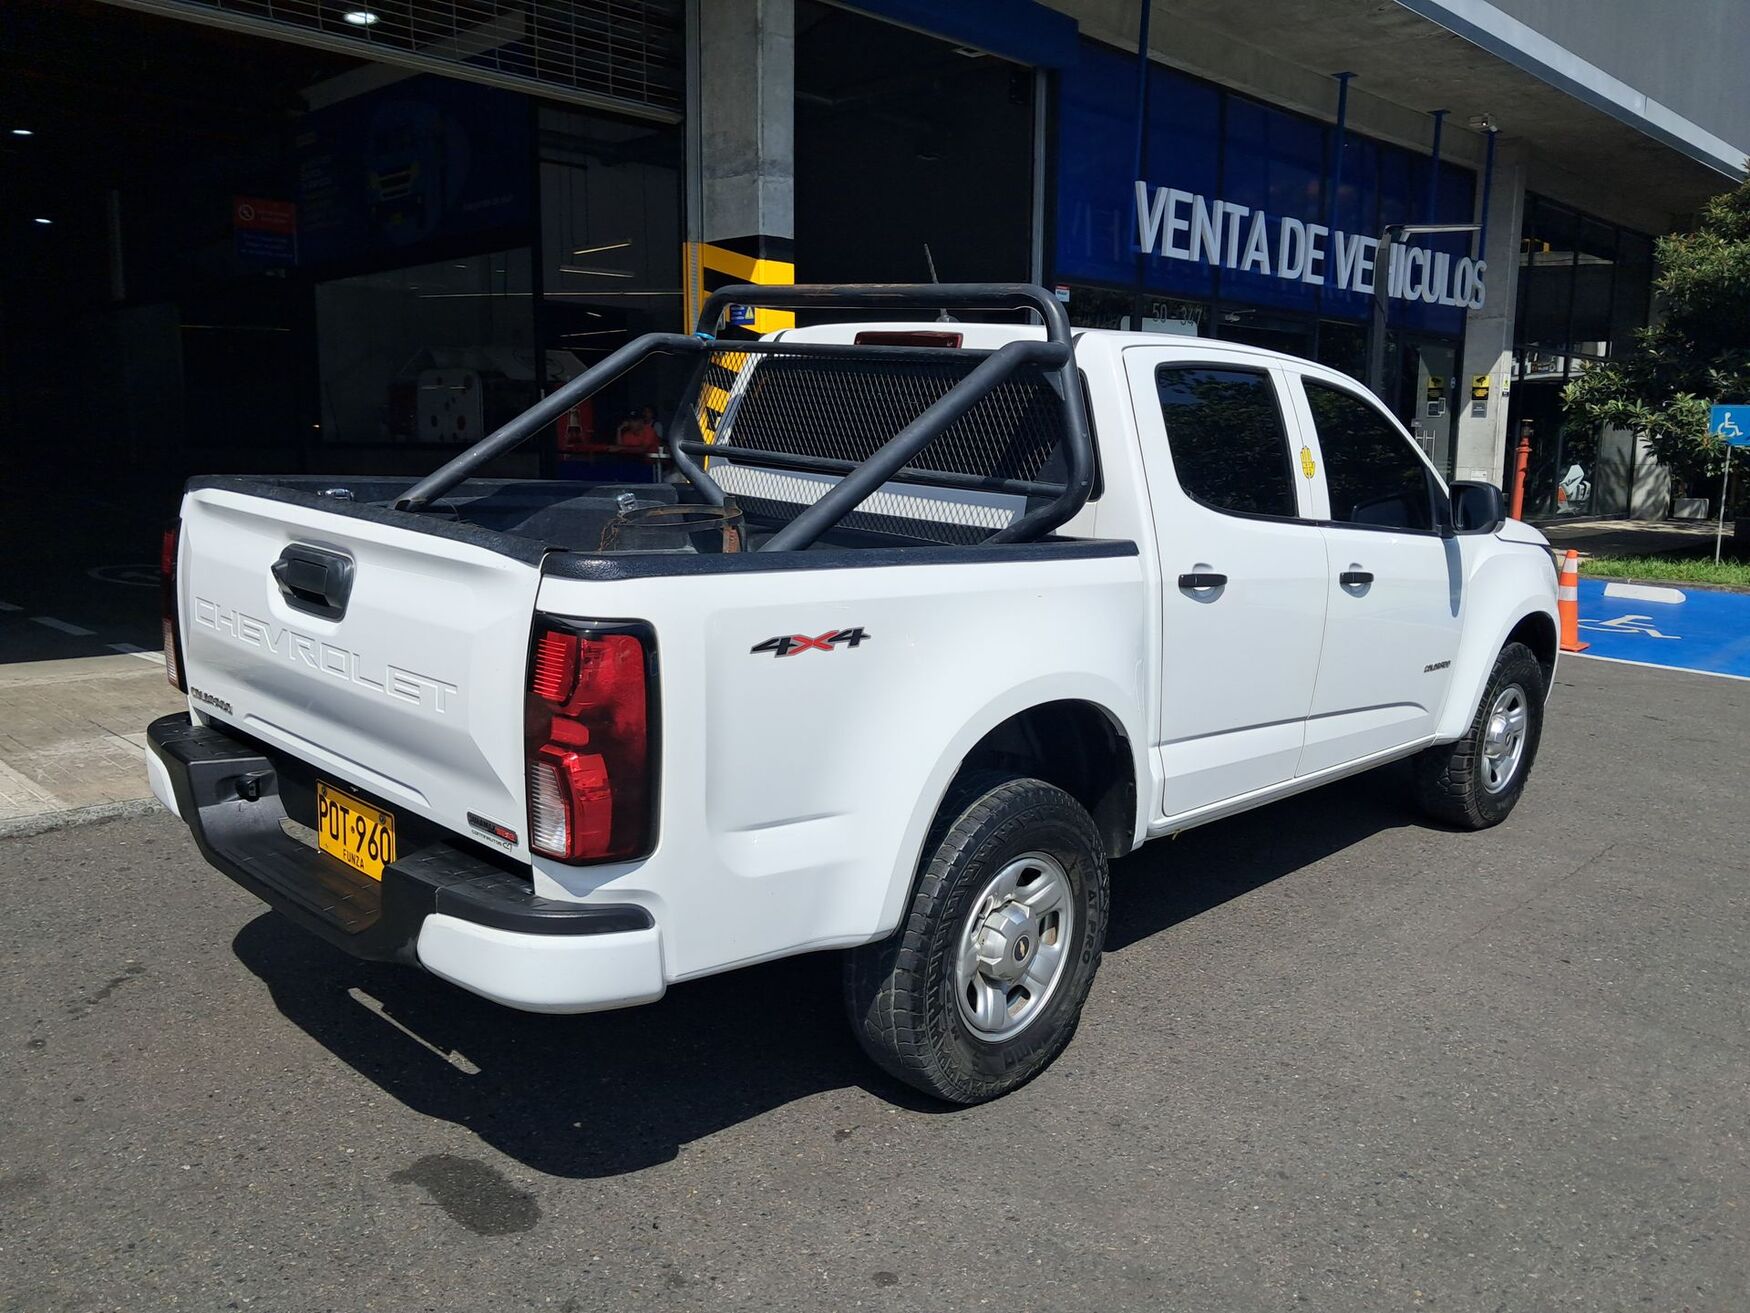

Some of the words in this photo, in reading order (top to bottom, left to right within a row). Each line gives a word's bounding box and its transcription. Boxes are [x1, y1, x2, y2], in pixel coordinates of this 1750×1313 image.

[1135, 180, 1271, 275] VENTA
[1278, 216, 1329, 286] DE
[1152, 302, 1168, 324] 50
[195, 596, 458, 714] CHEVROLET
[342, 848, 365, 870] FUNZA
[1082, 919, 1097, 965] PRO
